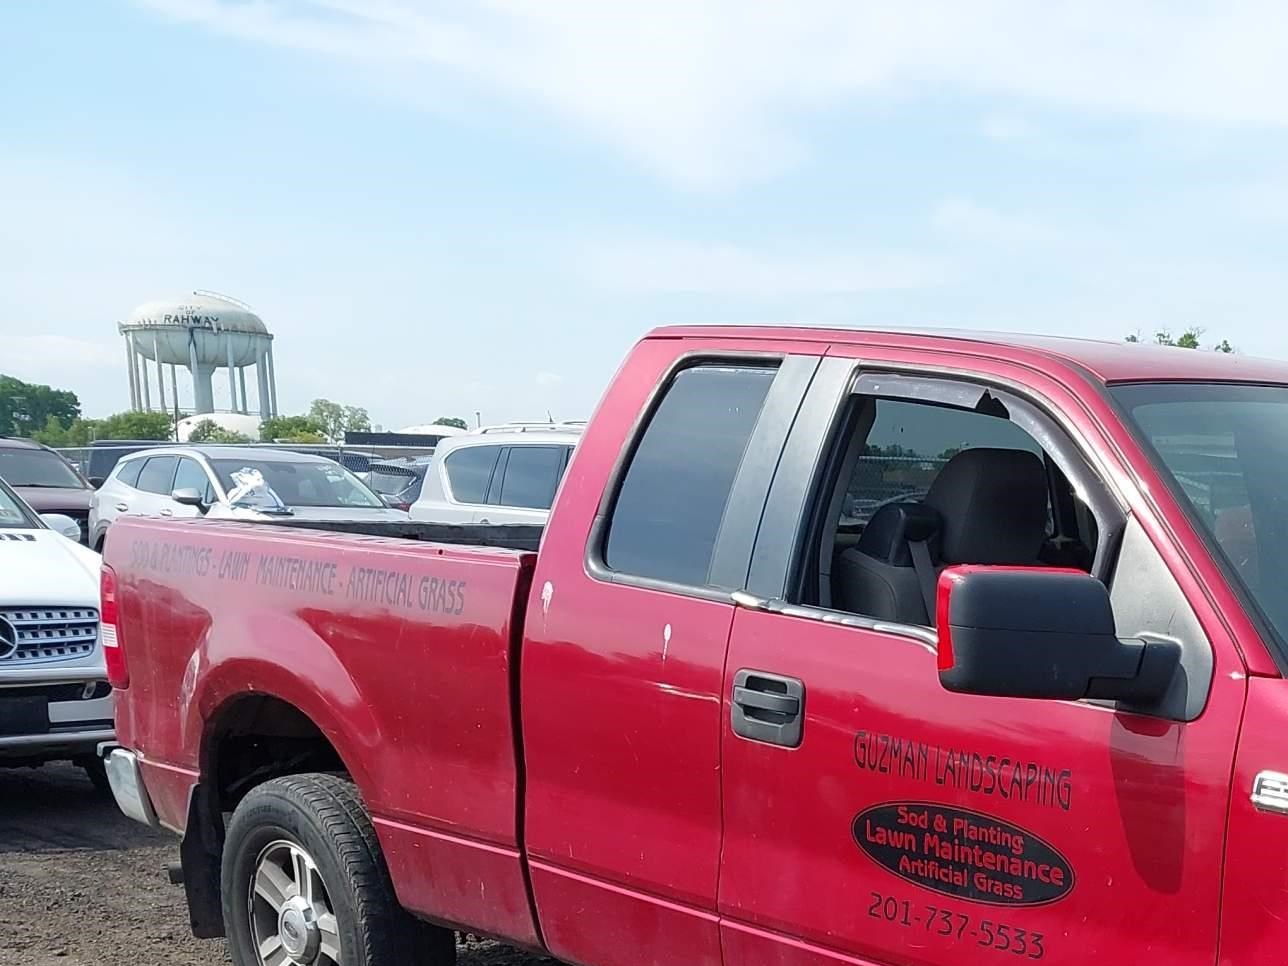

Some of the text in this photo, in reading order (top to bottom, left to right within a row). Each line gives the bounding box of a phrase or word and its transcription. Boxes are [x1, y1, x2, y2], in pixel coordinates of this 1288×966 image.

[163, 314, 219, 325] RAHWAY
[218, 550, 250, 581] LAWN
[255, 553, 337, 596] MAINTENANCE
[346, 566, 413, 609] ARTIFICIAL
[418, 576, 466, 616] GRASS
[853, 731, 1072, 812] GUZMAN LANDSCAPING
[865, 819, 1065, 887] Lawn Maintenance
[897, 806, 1025, 855] Sod & Planting
[899, 854, 1024, 900] Artificial Grass
[868, 892, 1045, 960] 201-737-5533
